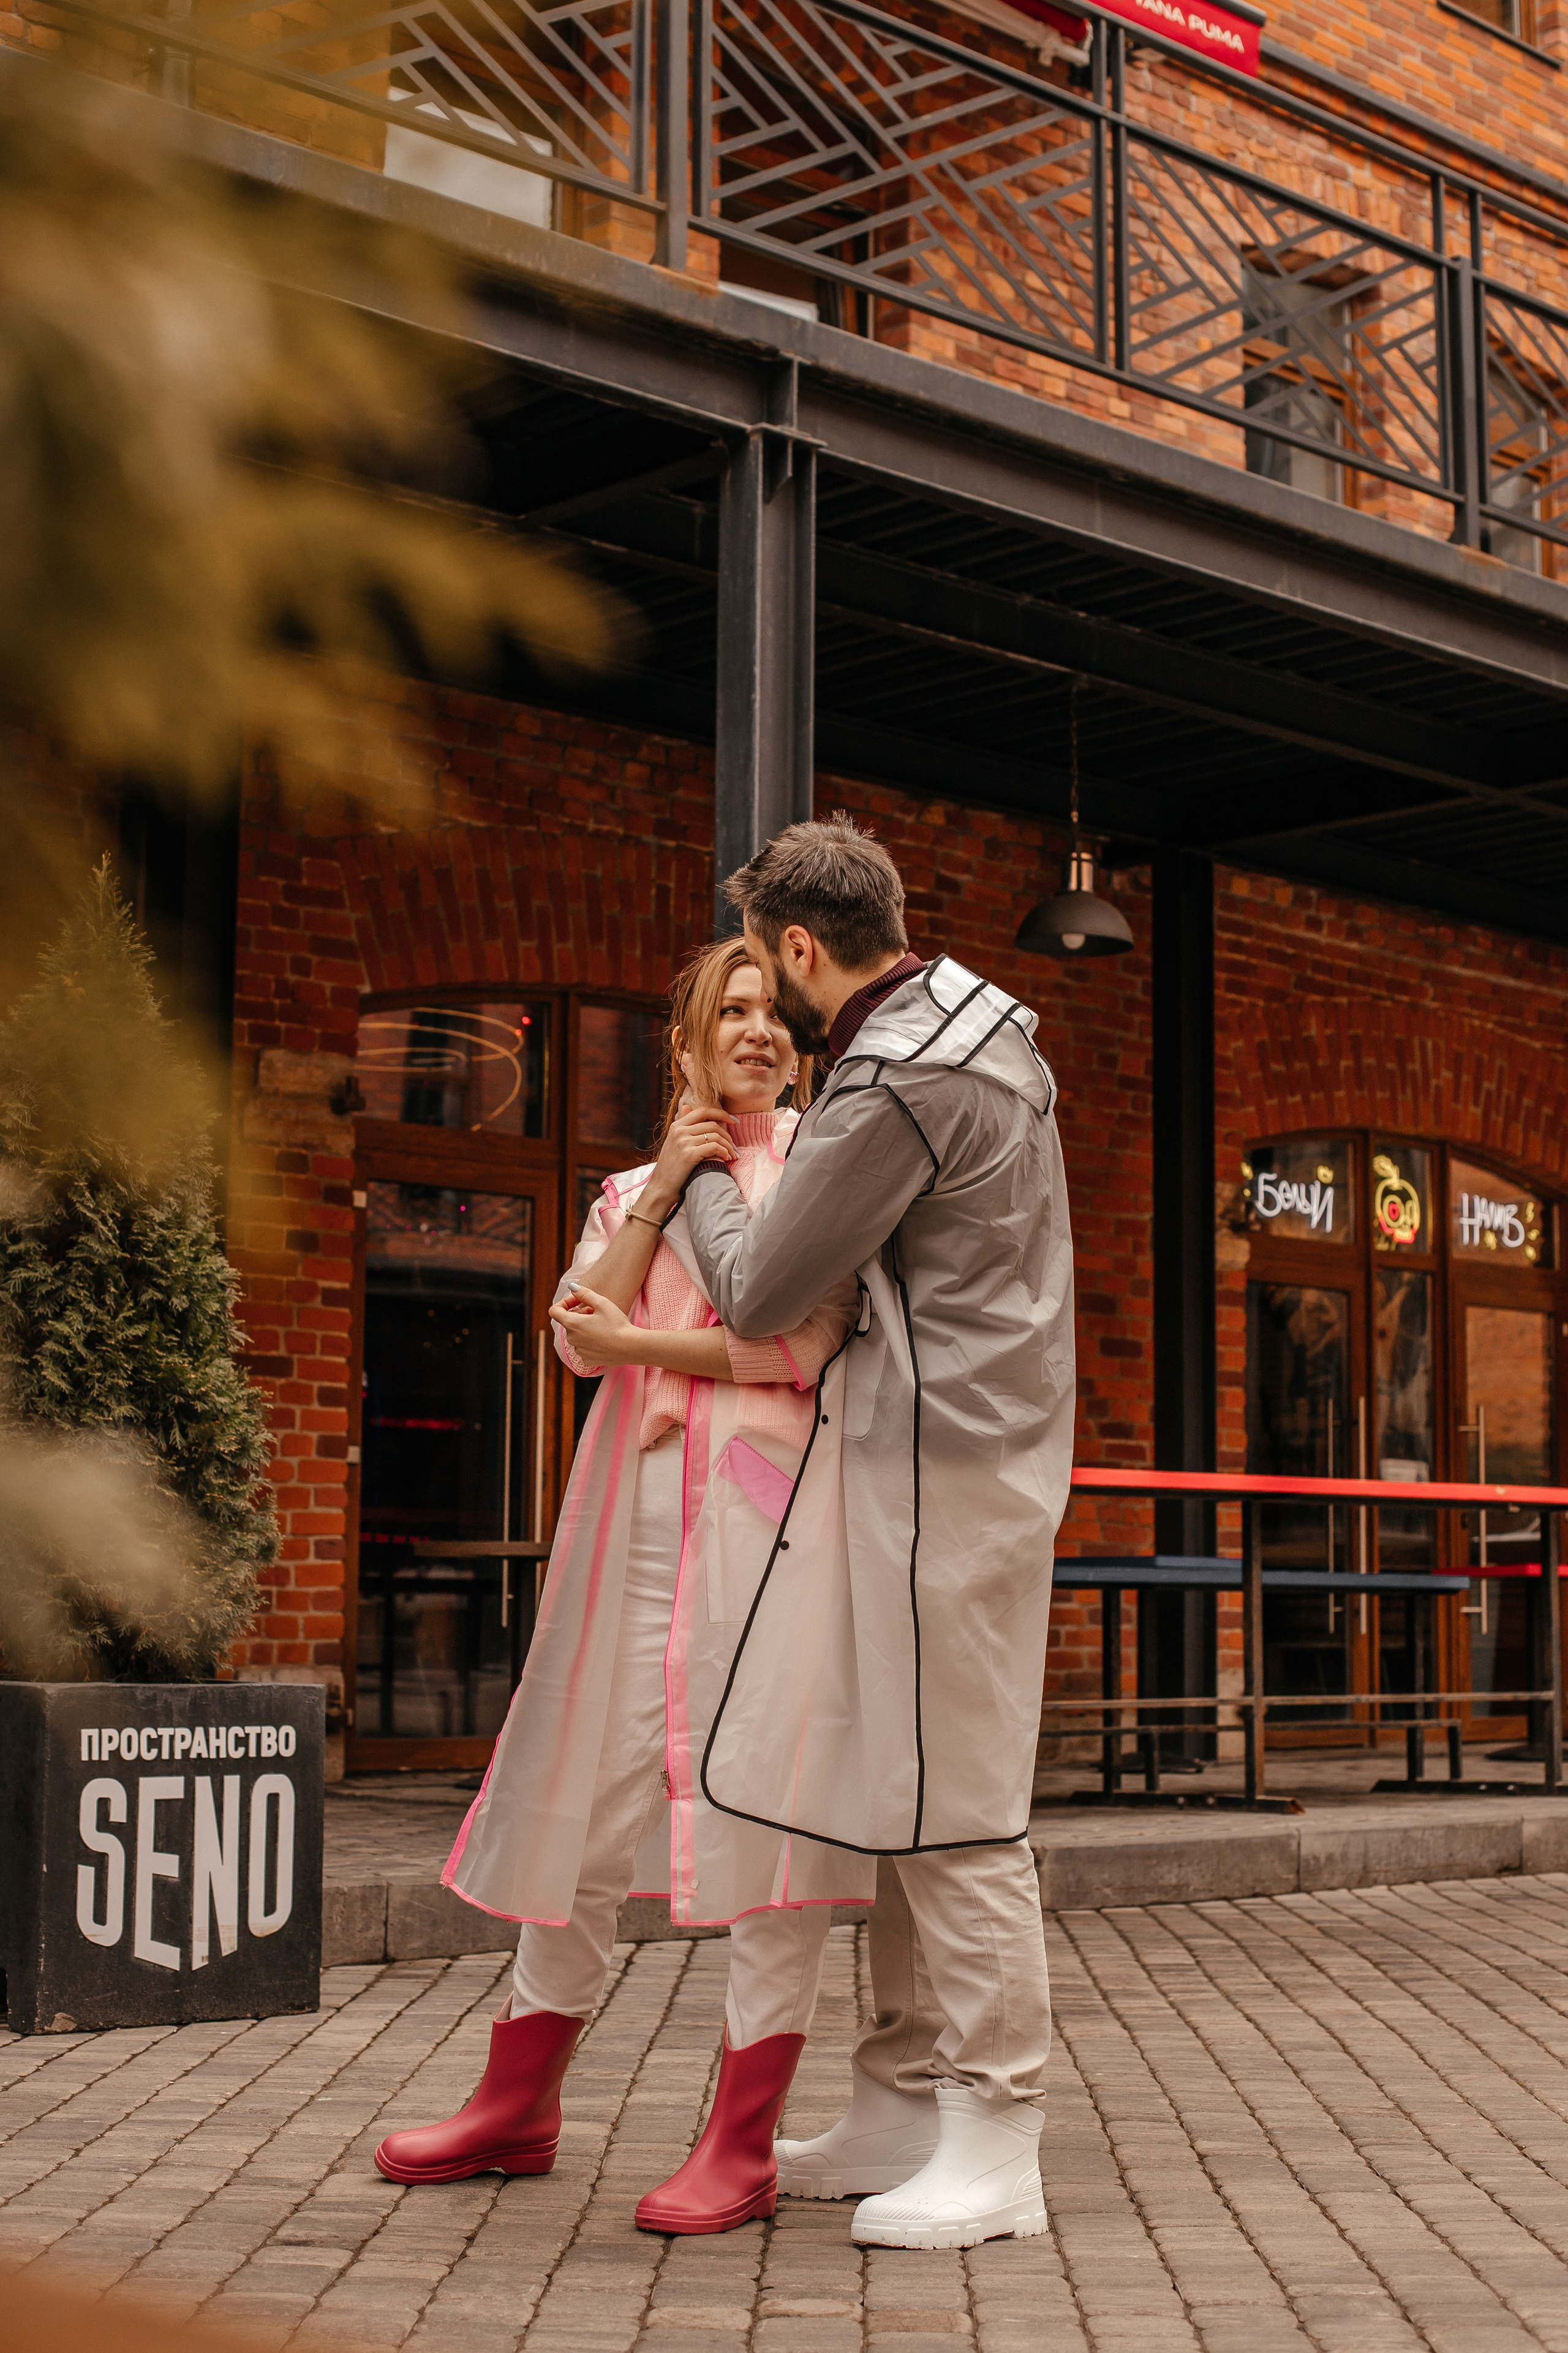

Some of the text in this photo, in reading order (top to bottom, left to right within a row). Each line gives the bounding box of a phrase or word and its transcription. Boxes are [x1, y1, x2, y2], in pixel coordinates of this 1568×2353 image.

[1188, 13, 1245, 53] PUMA
[80, 1724, 296, 1761] ПРОСТРАНСТВО
[77, 1773, 295, 1971] SENO
